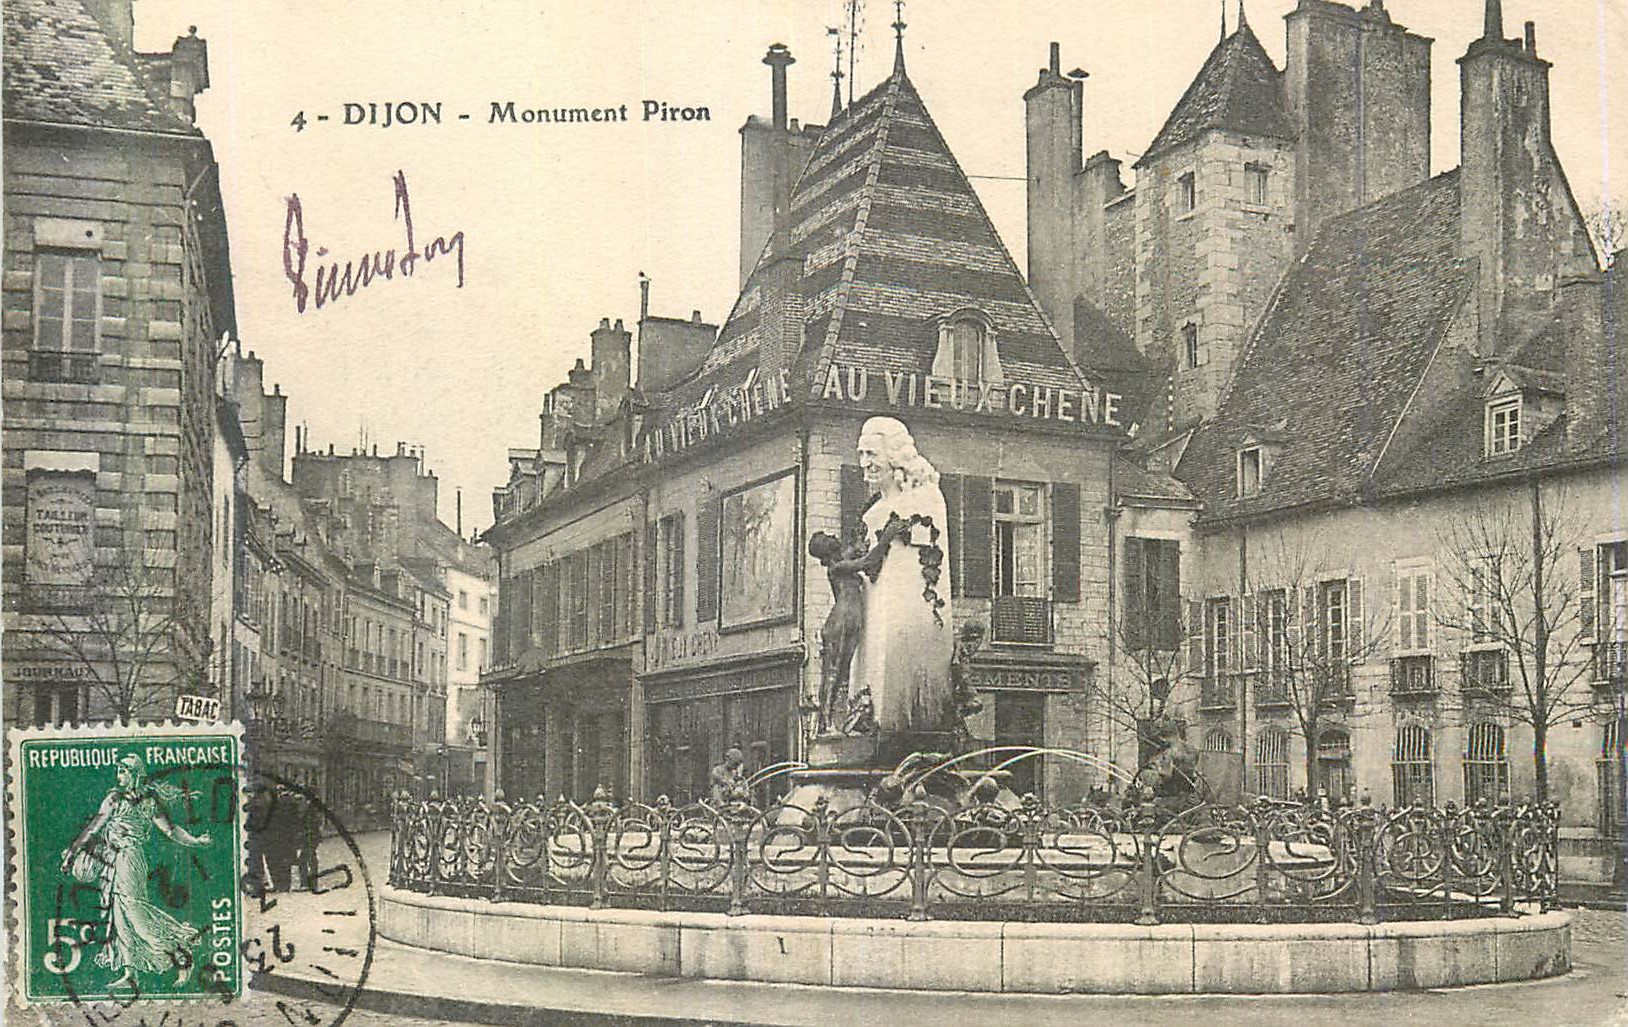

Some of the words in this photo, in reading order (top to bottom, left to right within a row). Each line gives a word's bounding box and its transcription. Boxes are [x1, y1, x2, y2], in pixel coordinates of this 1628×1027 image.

[823, 364, 868, 401] AU
[885, 371, 992, 413] VIEUX
[1008, 383, 1122, 426] CHENE
[180, 697, 219, 719] TABAC
[29, 748, 118, 769] REPUBLIQUE
[146, 746, 229, 767] FRANÇAISE
[211, 897, 232, 982] POSTES
